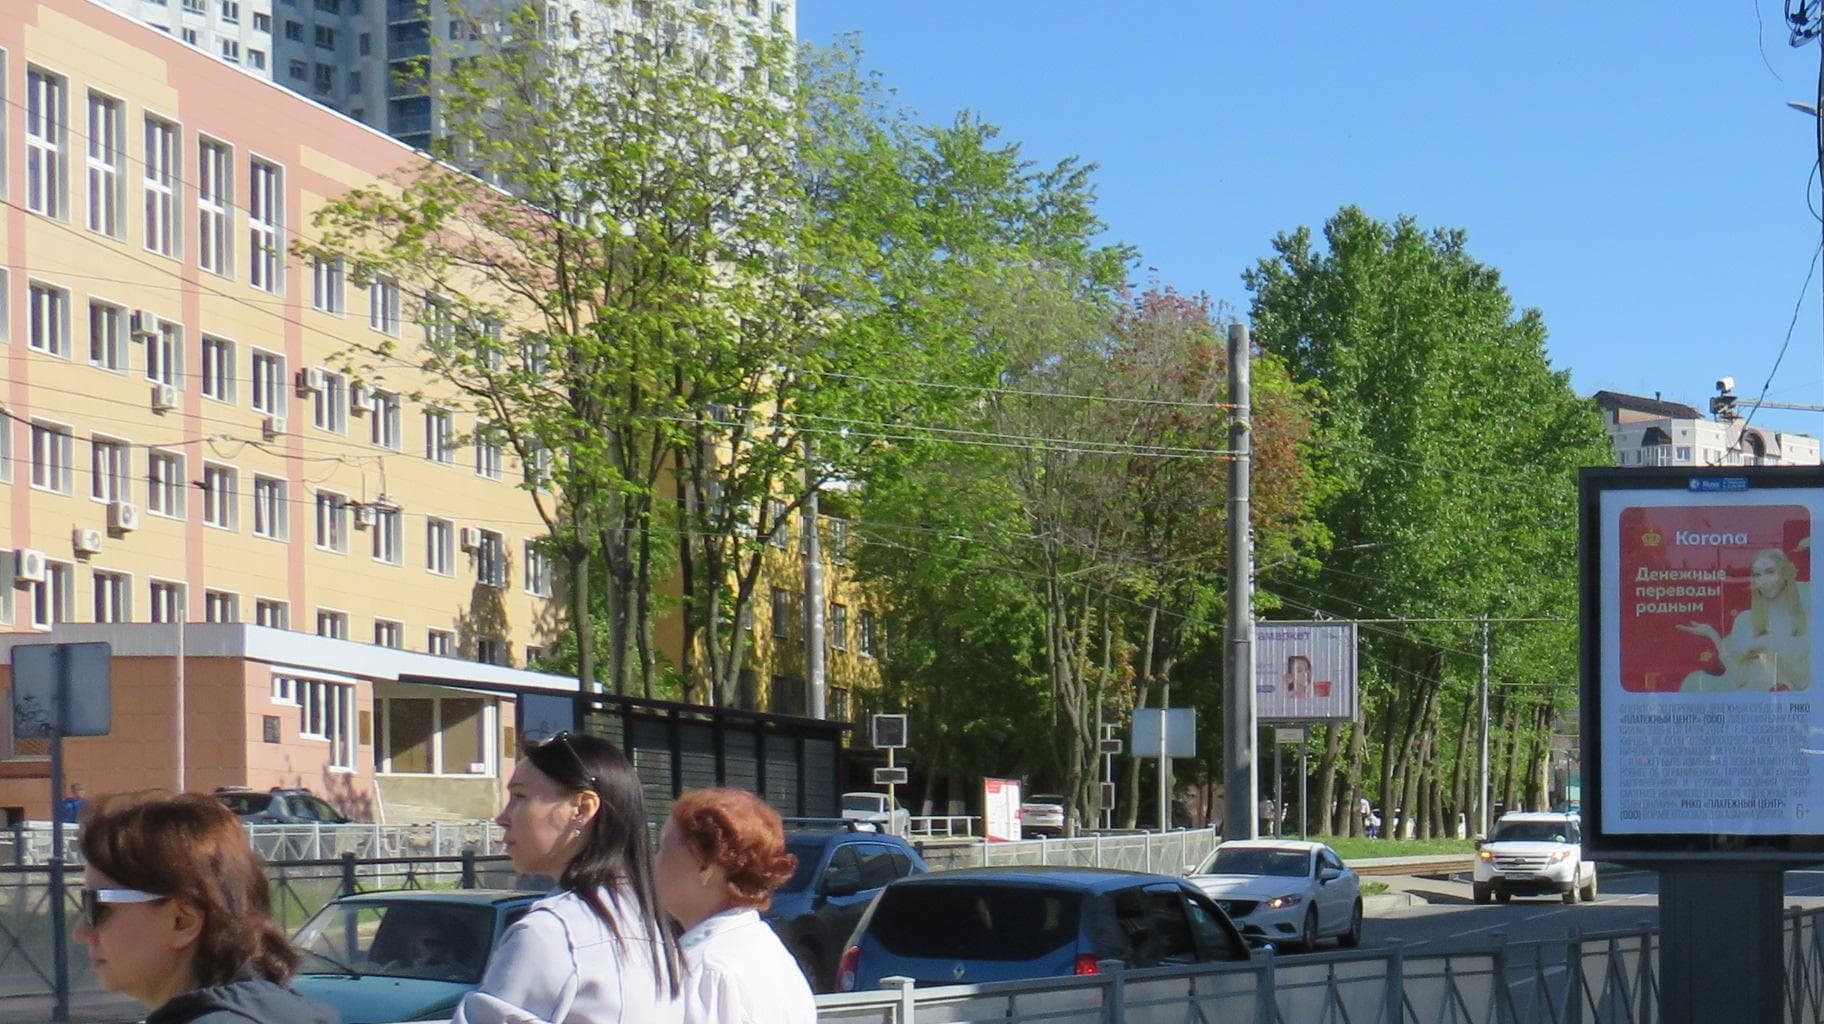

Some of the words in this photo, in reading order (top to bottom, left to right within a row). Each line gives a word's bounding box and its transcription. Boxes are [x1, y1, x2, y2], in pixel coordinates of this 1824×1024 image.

[1676, 530, 1748, 545] Korona
[1636, 567, 1727, 581] Денежные
[1636, 585, 1721, 599] переводы
[1636, 602, 1704, 616] родным
